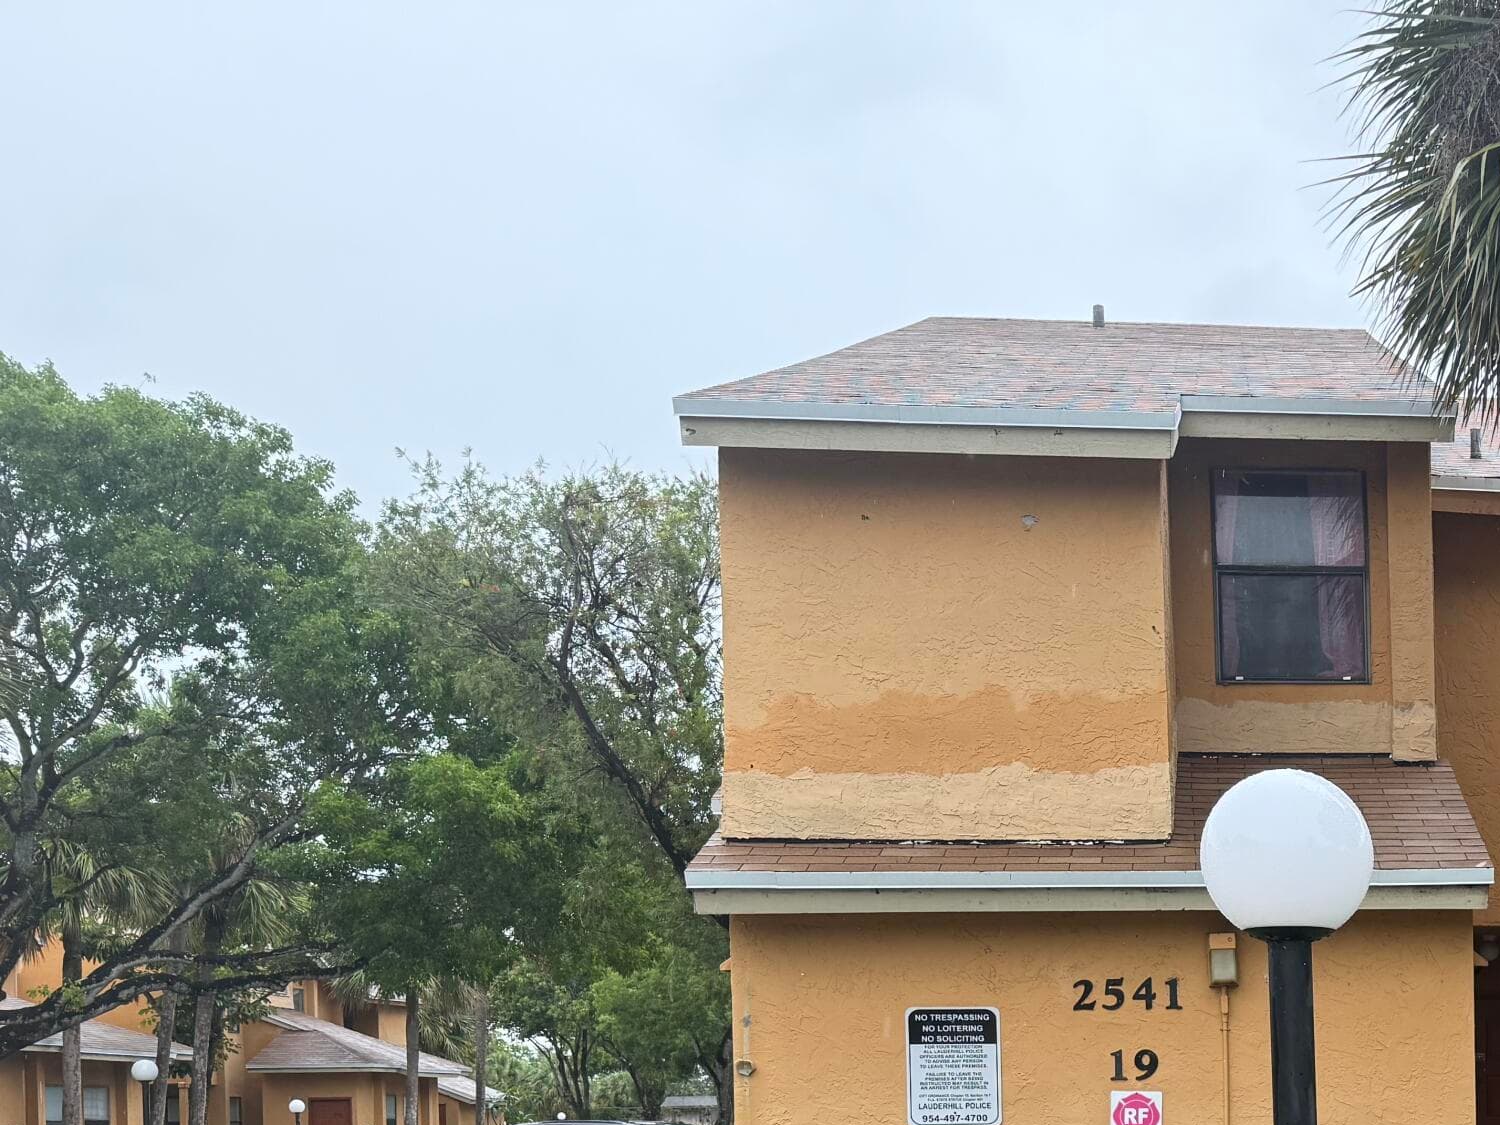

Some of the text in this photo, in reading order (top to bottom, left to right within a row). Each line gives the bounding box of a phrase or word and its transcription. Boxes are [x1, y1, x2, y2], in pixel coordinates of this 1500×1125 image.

[1073, 977, 1183, 1011] 2541
[1110, 1049, 1159, 1081] 19
[1124, 1108, 1150, 1125] RF
